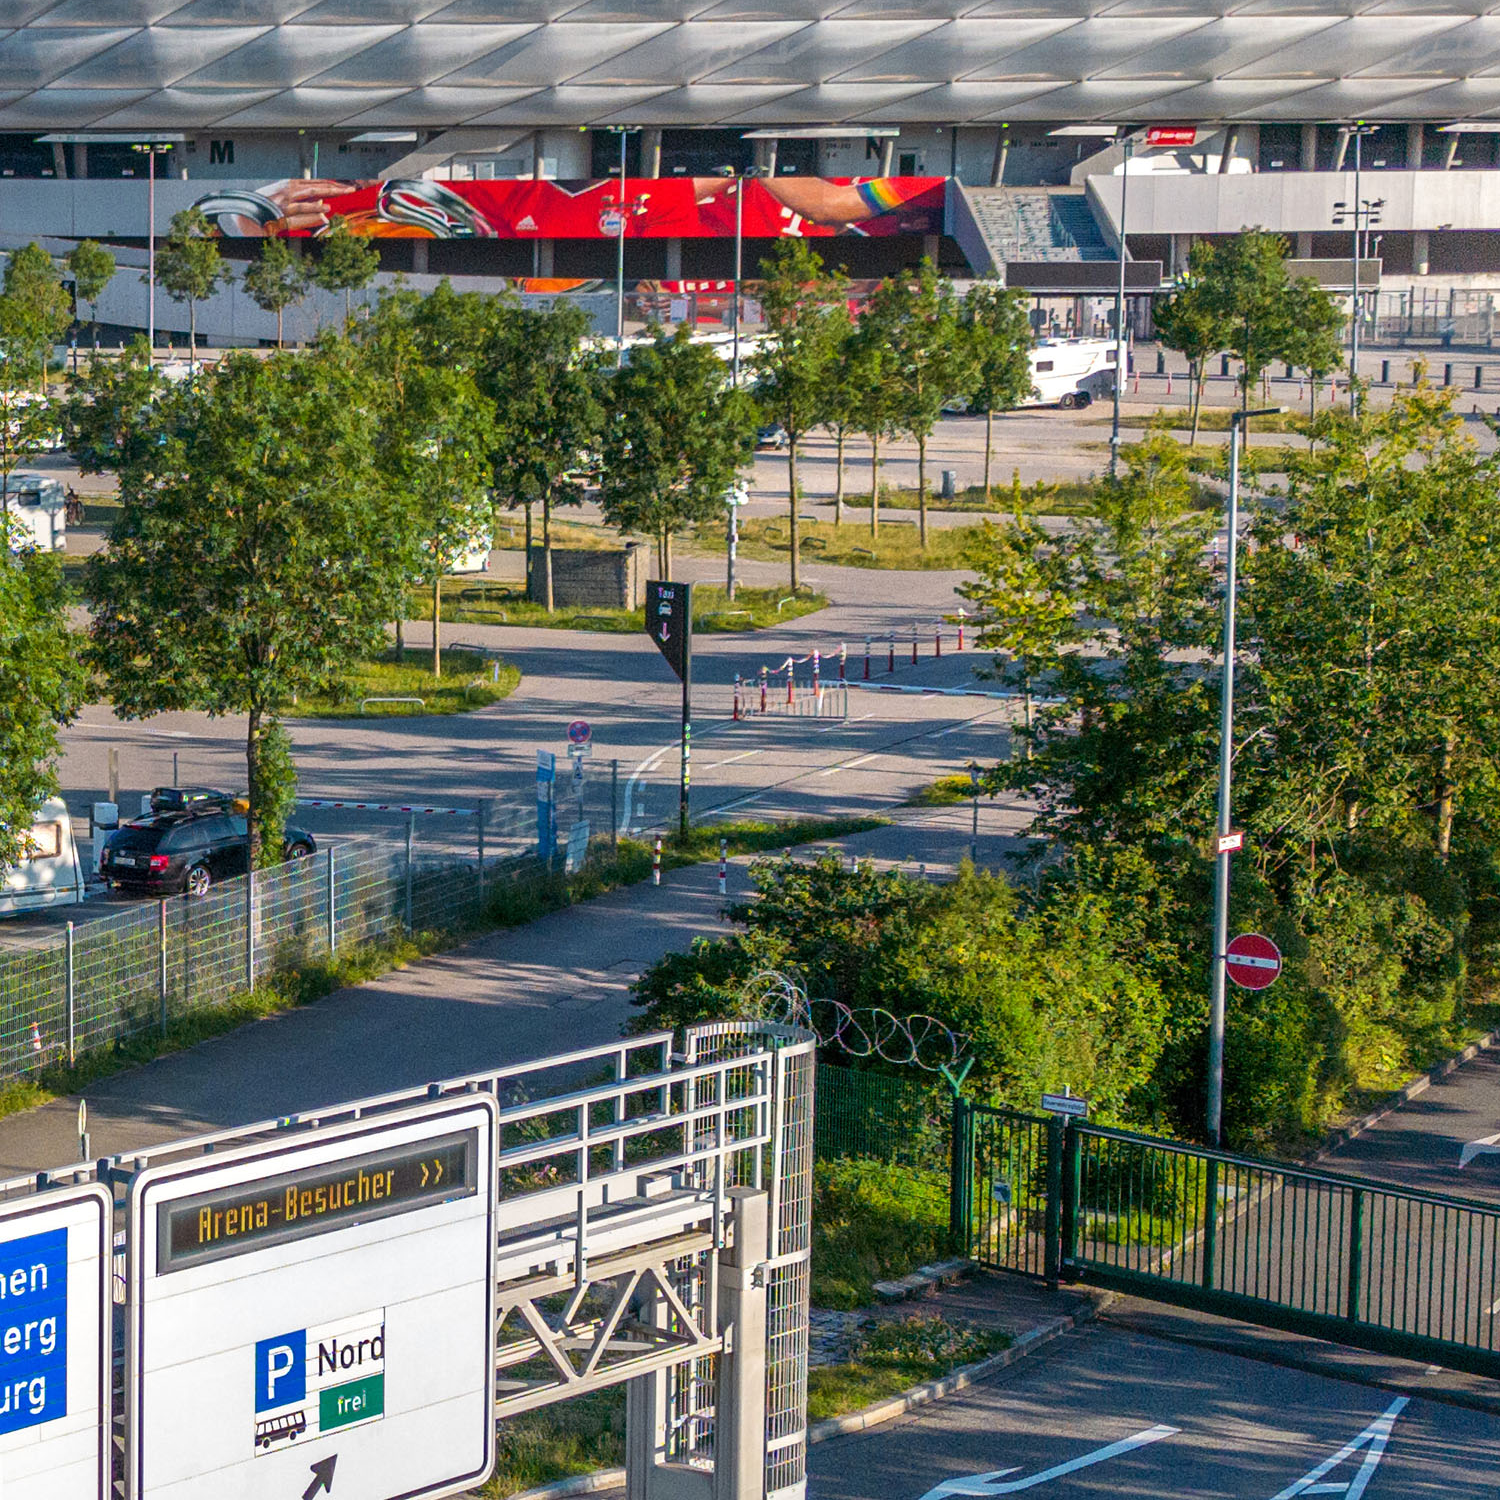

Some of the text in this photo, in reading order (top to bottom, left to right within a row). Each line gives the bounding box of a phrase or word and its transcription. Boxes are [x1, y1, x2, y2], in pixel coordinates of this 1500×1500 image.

[210, 140, 234, 164] M
[199, 1170, 394, 1242] Arena-Besucher
[267, 1325, 385, 1401] P Nord
[336, 1388, 367, 1417] frei
